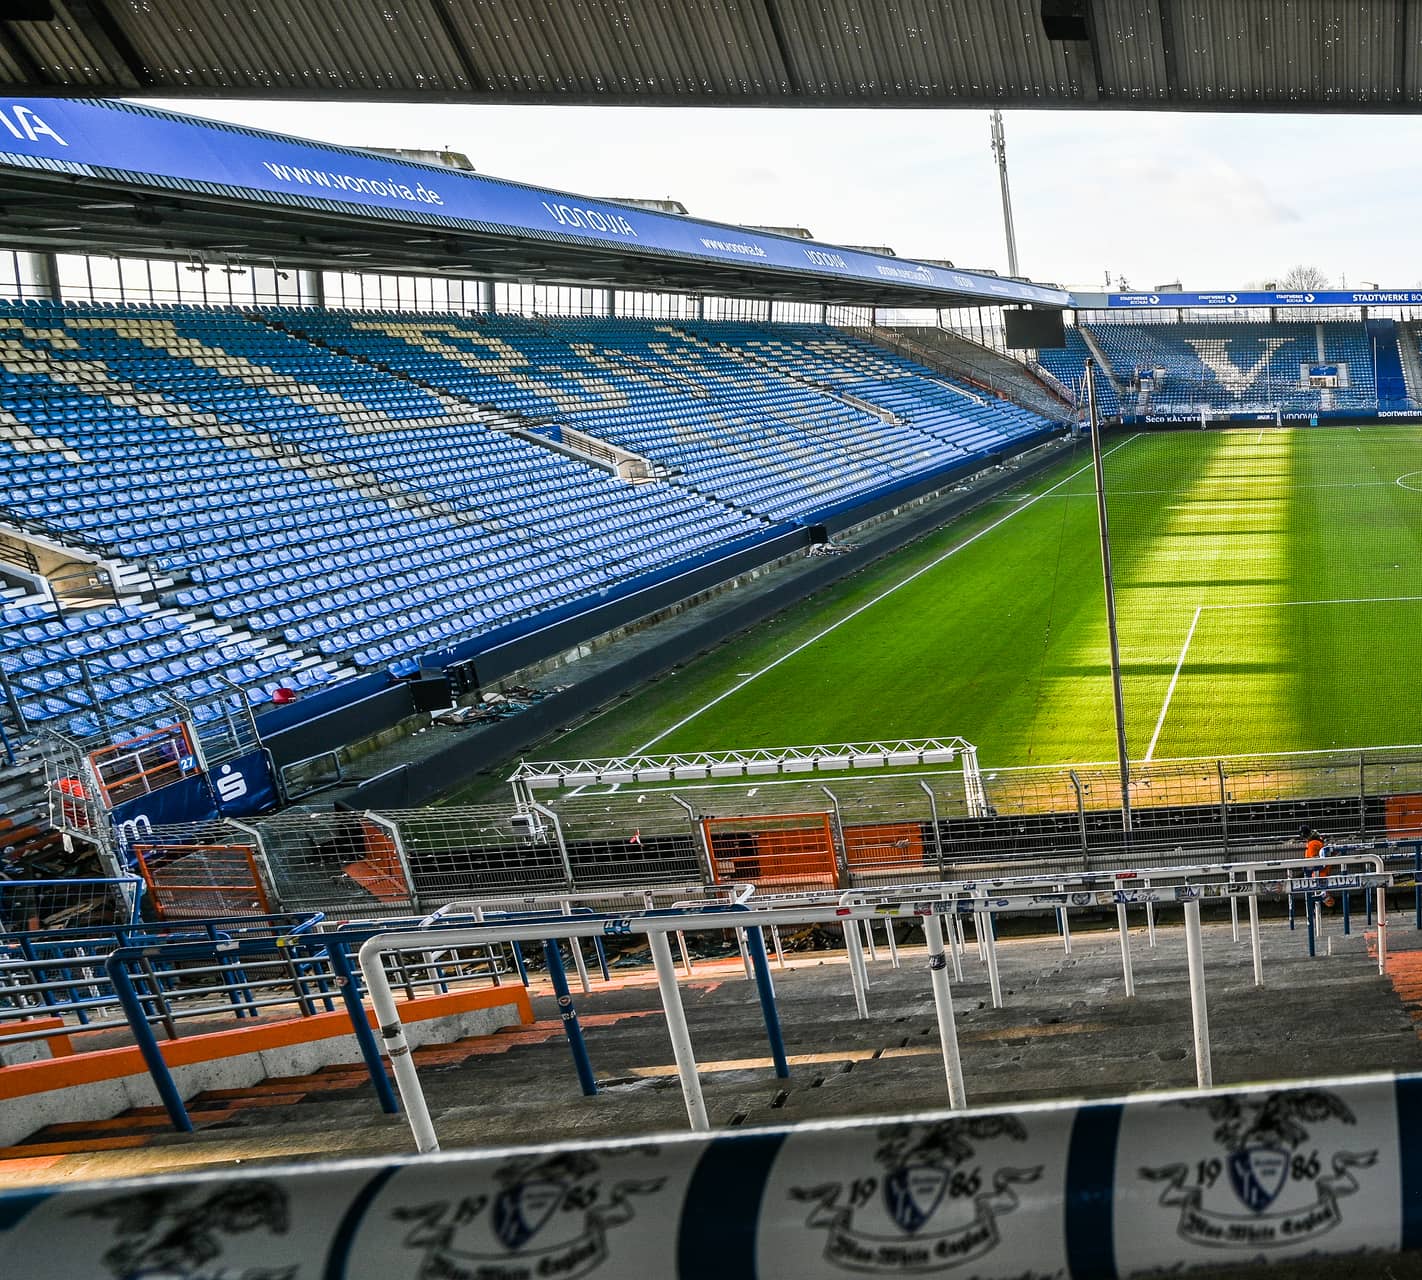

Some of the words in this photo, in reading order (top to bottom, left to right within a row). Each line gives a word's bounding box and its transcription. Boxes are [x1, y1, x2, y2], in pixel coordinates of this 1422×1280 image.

[263, 161, 443, 206] www.vonovia.de
[700, 238, 768, 257] www.vonovia.de
[1351, 293, 1409, 302] STADTWERKE
[180, 756, 194, 770] 27
[1196, 1157, 1222, 1188] 19
[1291, 1150, 1321, 1181] 86
[849, 1176, 878, 1207] 19
[949, 1165, 982, 1198] 86
